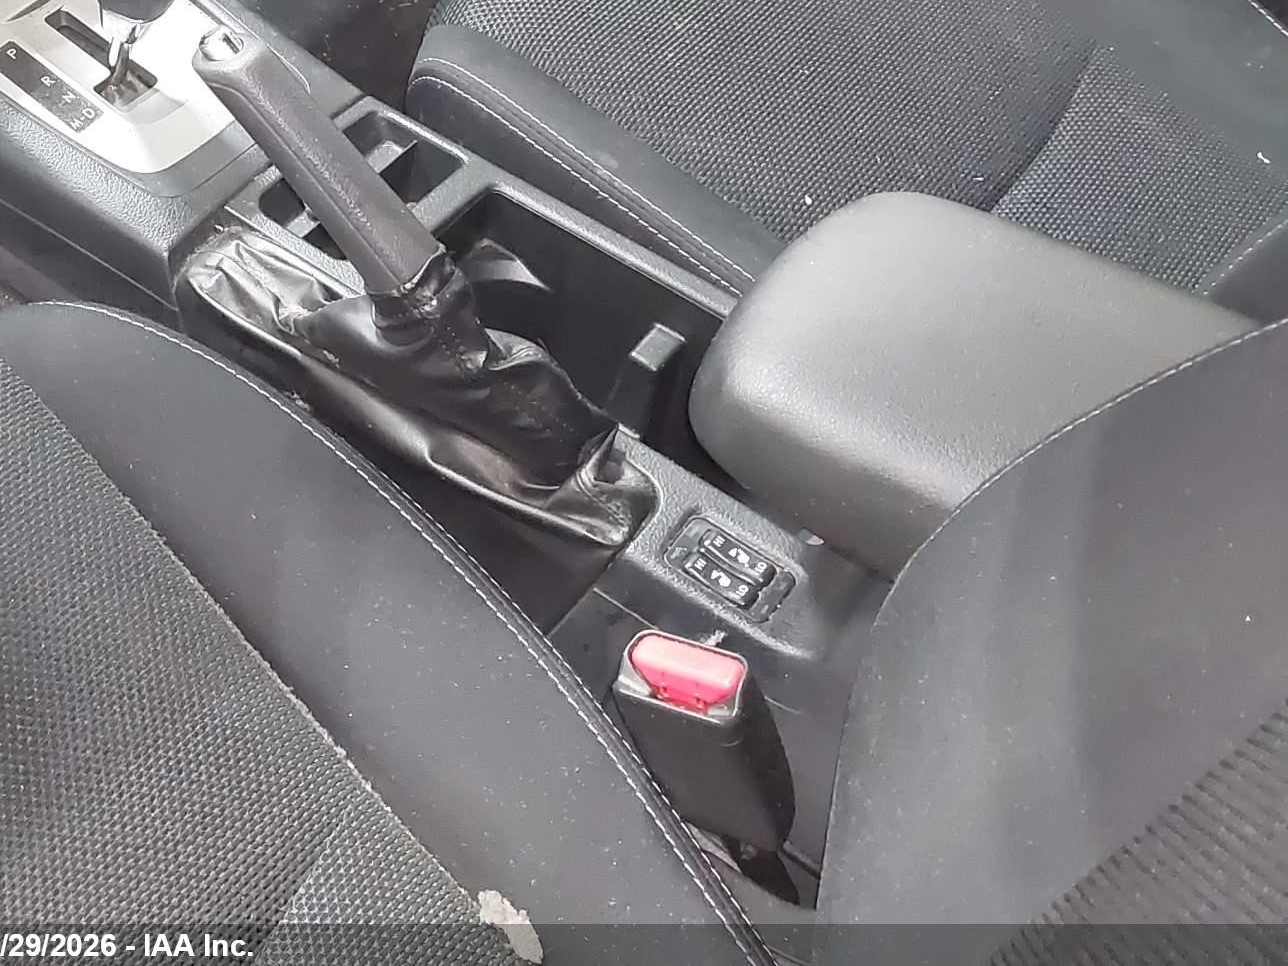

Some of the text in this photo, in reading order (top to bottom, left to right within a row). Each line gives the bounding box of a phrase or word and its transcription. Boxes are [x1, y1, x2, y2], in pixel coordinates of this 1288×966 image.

[6, 48, 18, 60] P
[40, 75, 56, 88] R
[712, 535, 727, 548] HI
[694, 557, 708, 571] HI
